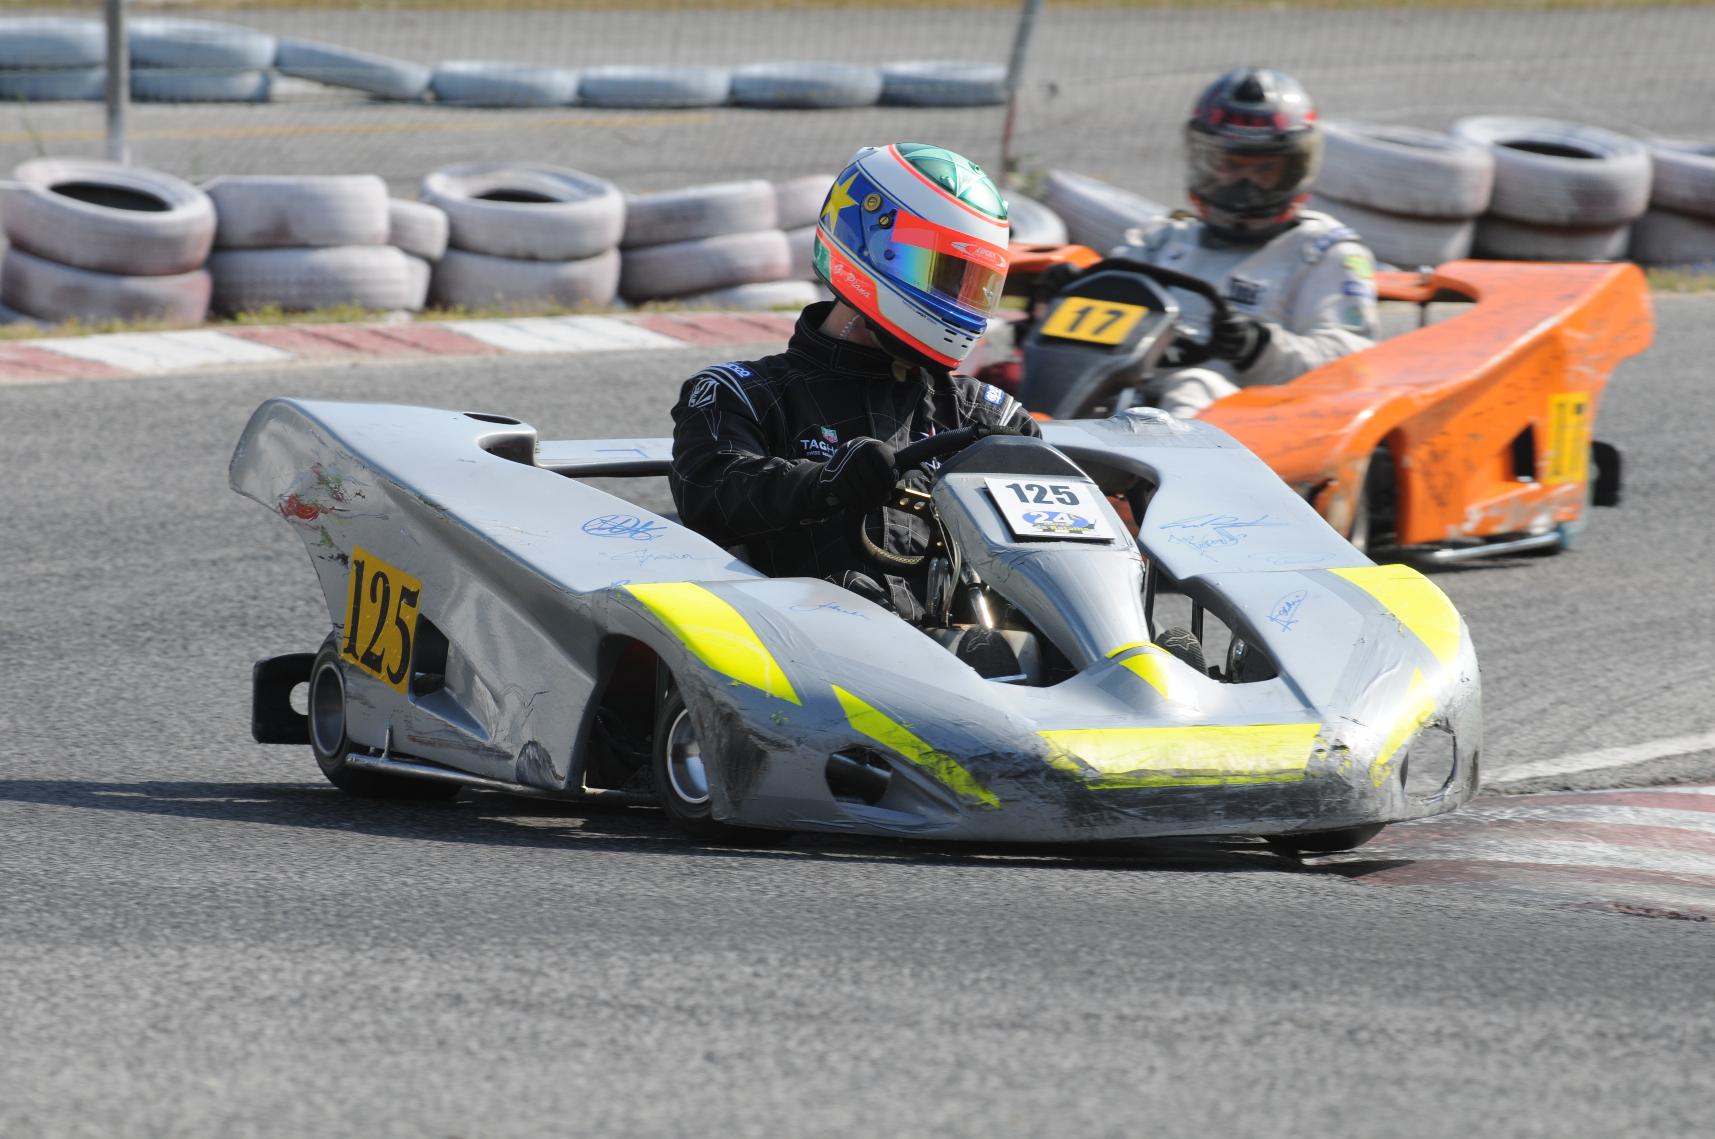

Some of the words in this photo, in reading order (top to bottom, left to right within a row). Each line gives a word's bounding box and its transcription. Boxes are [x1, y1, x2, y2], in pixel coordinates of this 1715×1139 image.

[1066, 305, 1126, 336] 17
[1005, 483, 1080, 506] 125
[343, 559, 420, 685] 125
